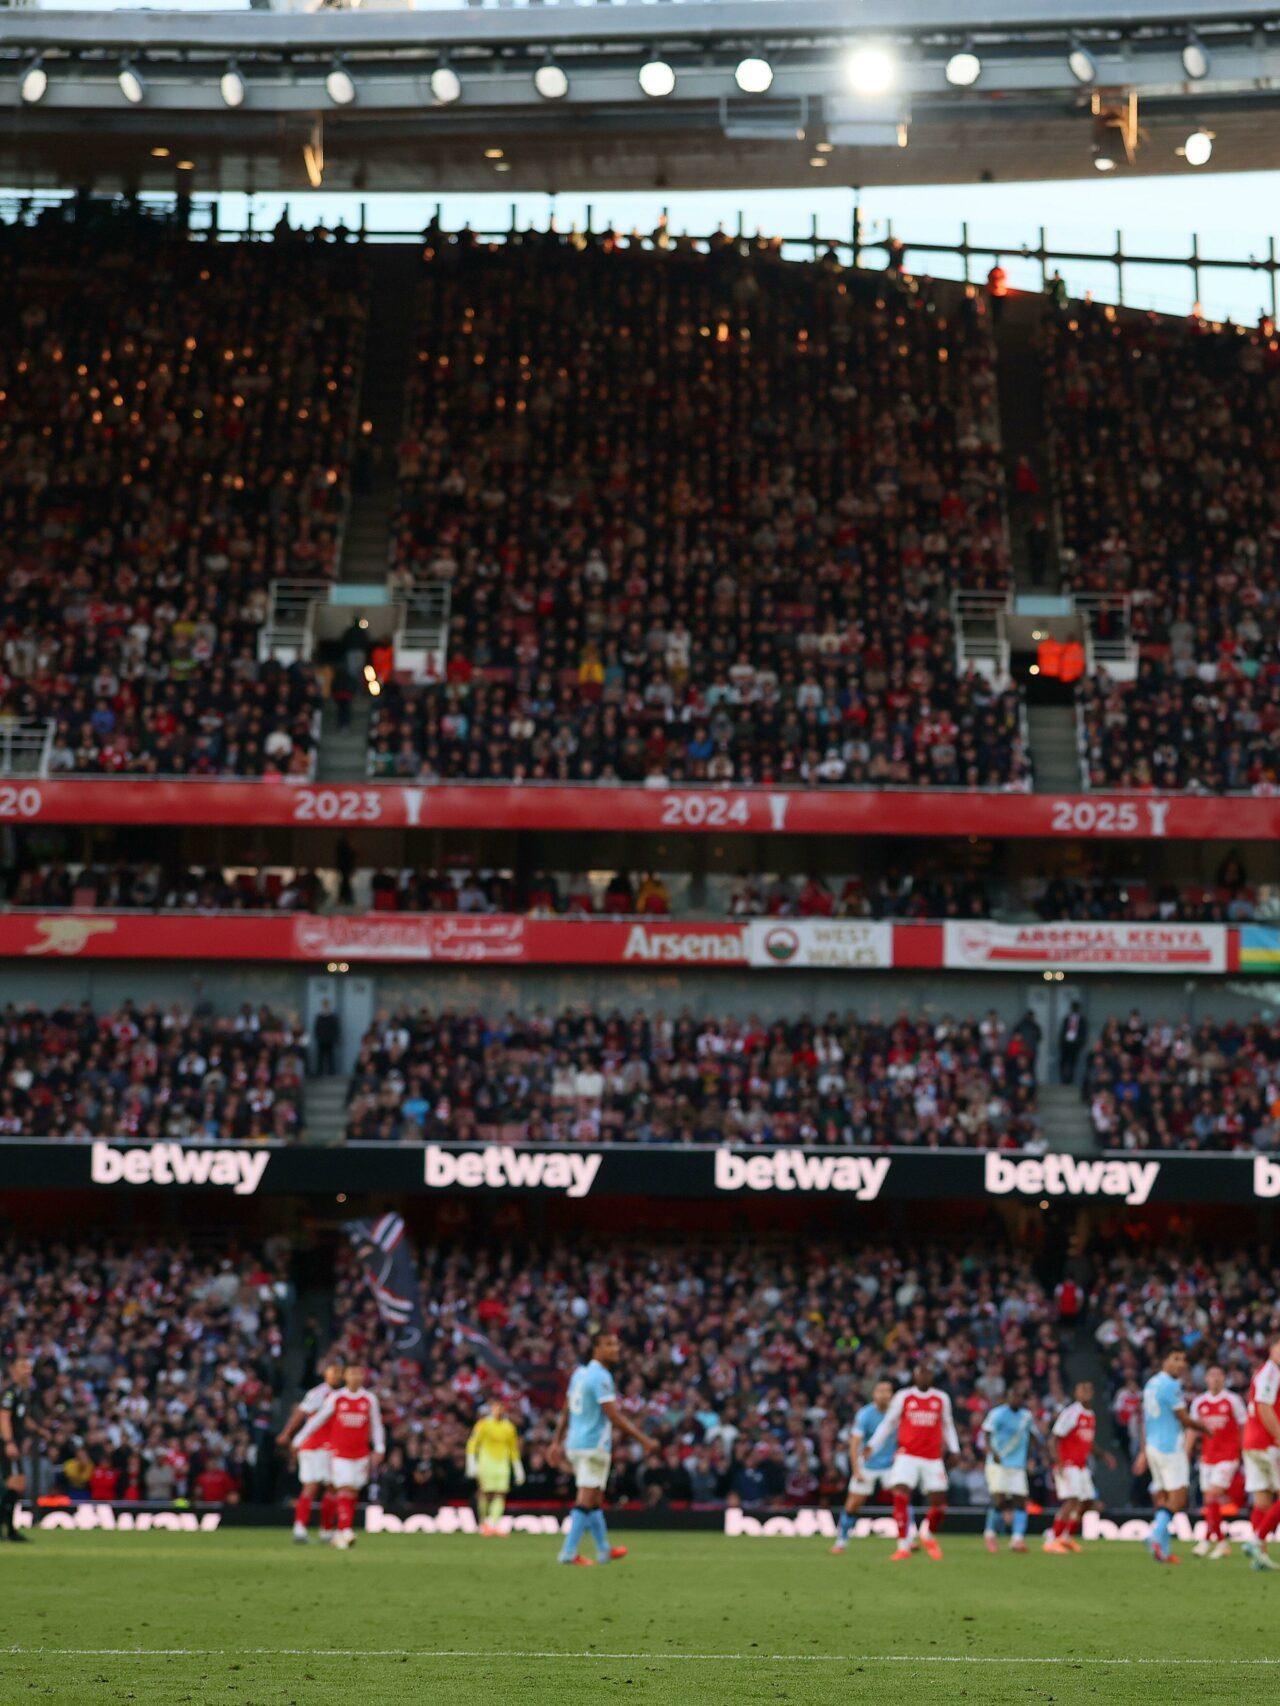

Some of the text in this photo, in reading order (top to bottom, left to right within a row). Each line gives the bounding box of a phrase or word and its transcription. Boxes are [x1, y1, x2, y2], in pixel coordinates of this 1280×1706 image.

[294, 789, 381, 820] 2023
[661, 796, 749, 825] 2024
[1052, 802, 1138, 832] 2025
[623, 925, 748, 960] Arsenal
[813, 928, 870, 943] WEST
[1016, 929, 1204, 945] ARSENAL KENYA
[807, 948, 879, 965] WALES
[92, 1142, 270, 1194] betway
[424, 1145, 602, 1197] betway
[715, 1149, 891, 1200] betway
[985, 1151, 1160, 1205] betway
